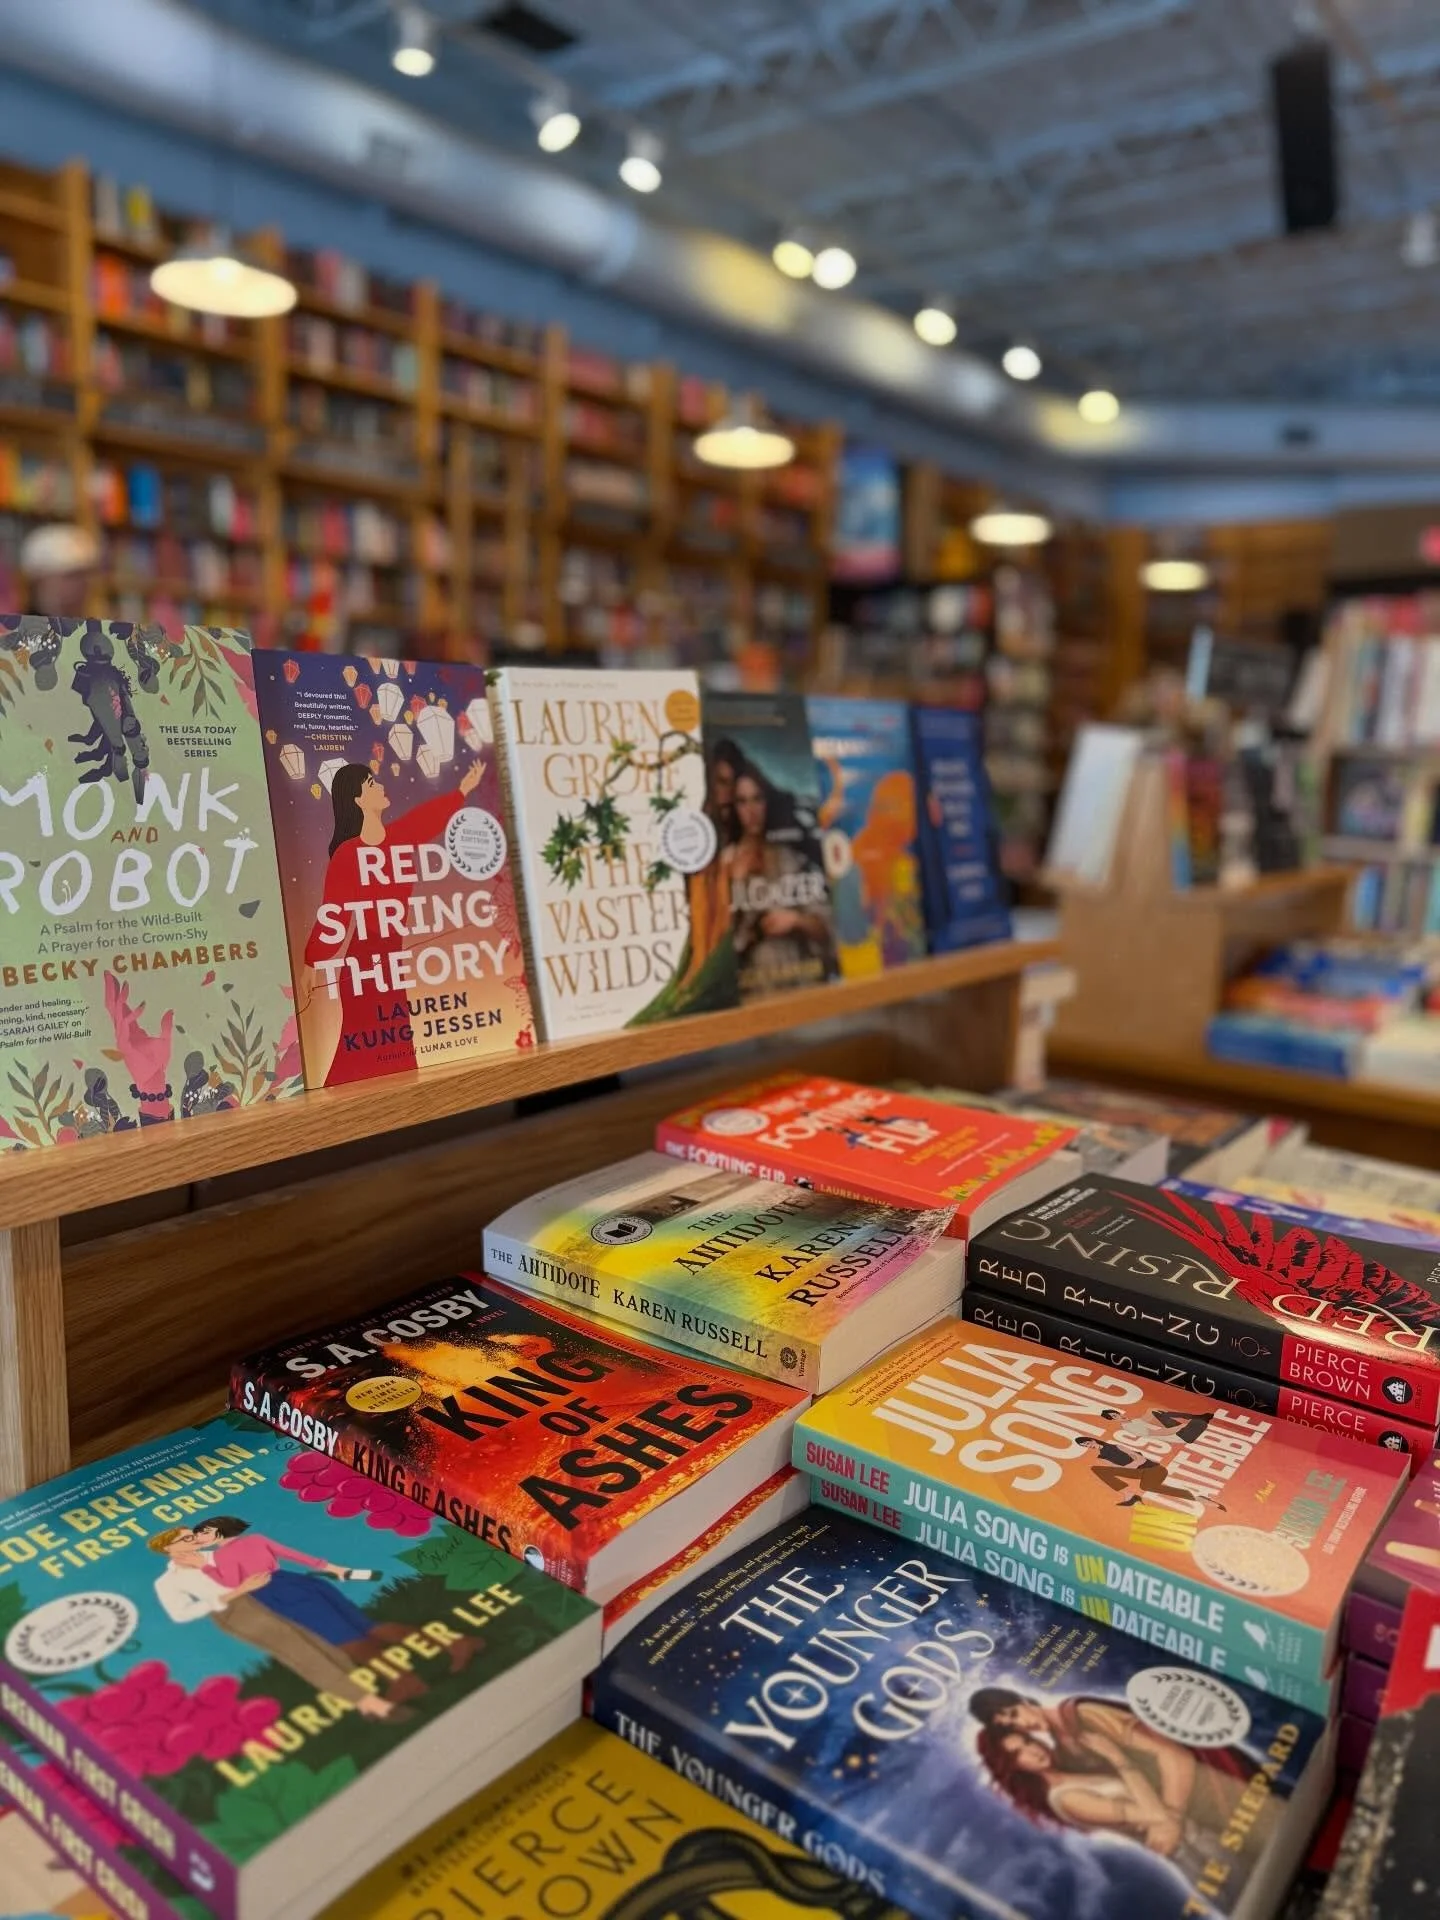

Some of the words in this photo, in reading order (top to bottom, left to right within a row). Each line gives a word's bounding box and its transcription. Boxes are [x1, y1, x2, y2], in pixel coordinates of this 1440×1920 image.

[294, 701, 327, 710] Beautifully
[304, 691, 332, 699] devoured
[511, 699, 661, 746] LAUREN
[159, 725, 179, 734] THE
[181, 725, 201, 734] USA
[204, 725, 237, 735] TODAY
[167, 737, 232, 746] BESTSELLING
[184, 749, 218, 758] SERIES
[0, 767, 240, 841] MONK
[544, 752, 680, 798] GROFF
[110, 826, 159, 844] AND
[0, 838, 259, 915] ROBOT
[356, 842, 451, 888] RED
[575, 842, 650, 890] THE
[38, 942, 49, 955] A
[51, 937, 93, 955] Prayer
[97, 936, 115, 949] for
[118, 933, 139, 946] the
[142, 928, 208, 943] Crown-Shy
[40, 925, 50, 936] A
[54, 921, 93, 936] Psalm
[96, 919, 115, 932] for
[118, 917, 138, 930] the
[141, 912, 202, 927] Wild-Built
[316, 890, 497, 946] STRING
[547, 890, 690, 944] VASTER
[2, 958, 98, 988] BECKY
[113, 941, 258, 973] CHAMBERS
[313, 938, 511, 1000] THEORY
[543, 940, 677, 998] WILDS
[24, 1001, 40, 1010] and
[26, 1012, 45, 1022] kind,
[37, 1021, 69, 1031] GAILEY
[343, 1024, 414, 1052] KUNG
[423, 1008, 502, 1037] JESSEN
[377, 991, 468, 1022] LAUREN
[26, 1038, 37, 1046] for
[39, 1035, 52, 1043] the
[53, 1029, 92, 1041] Wild-Built
[420, 1041, 452, 1054] LUNAR
[455, 1036, 478, 1047] LOVE
[665, 1141, 684, 1157] THE
[688, 1144, 756, 1178] FORTUNE
[820, 1184, 860, 1202] LAUREN
[674, 1195, 815, 1275] ANTIDOTE
[688, 1209, 733, 1232] THE
[754, 1220, 863, 1283] KAREN
[787, 1225, 915, 1307] RUSSELL
[1000, 1219, 1243, 1301] RISING
[362, 1289, 492, 1347] COSBY
[476, 1310, 507, 1325] NOVEL
[491, 1248, 513, 1265] THE
[518, 1254, 601, 1299] ANTIDOTE
[612, 1288, 676, 1325] KAREN
[681, 1314, 768, 1358] RUSSELL
[979, 1260, 1046, 1295] RED
[1065, 1285, 1219, 1346] RISING
[1295, 1344, 1370, 1379] PIERCE
[1273, 1293, 1440, 1354] RED
[355, 1389, 373, 1399] NEW
[375, 1380, 396, 1391] YORK
[368, 1386, 416, 1410] BESTSELLER
[372, 1387, 397, 1400] TIMES
[423, 1352, 614, 1442] KING
[721, 1376, 744, 1388] POST
[975, 1308, 1041, 1343] RED
[1060, 1337, 1215, 1397] RISING
[1291, 1396, 1366, 1432] PIERCE
[1289, 1362, 1371, 1400] BROWN
[539, 1398, 610, 1436] OF
[872, 1343, 1057, 1456] JULIA
[959, 1364, 1144, 1492] SONG
[279, 1401, 339, 1456] COSBY
[353, 1442, 406, 1494] KING
[411, 1481, 429, 1505] OF
[435, 1489, 512, 1554] ASHES
[518, 1384, 753, 1532] ASHES
[60, 1443, 269, 1533] BRENNAN,
[40, 1518, 148, 1578] FIRST
[152, 1468, 268, 1524] CRUSH
[807, 1441, 855, 1479] SUSAN
[860, 1463, 890, 1494] LEE
[904, 1481, 968, 1530] JULIA
[974, 1510, 1047, 1560] SONG
[1053, 1543, 1069, 1566] IS
[1074, 1553, 1226, 1634] UNDATEABLE
[653, 1624, 671, 1639] work
[670, 1616, 678, 1625] of
[678, 1608, 689, 1618] art
[698, 1588, 716, 1600] This
[715, 1567, 748, 1589] enthralling
[716, 1590, 735, 1603] York
[732, 1578, 752, 1592] Times
[750, 1557, 781, 1580] bestselling
[719, 1567, 844, 1644] THE
[821, 1480, 869, 1520] SUSAN
[873, 1500, 902, 1530] LEE
[915, 1523, 977, 1567] JULIA
[984, 1549, 1054, 1599] SONG
[1061, 1584, 1074, 1605] IS
[1081, 1597, 1227, 1674] UNDATEABLE
[724, 1558, 970, 1751] YOUNGER
[853, 1619, 994, 1741] GODS
[216, 1691, 359, 1788] LAURA
[350, 1620, 464, 1695] PIPER
[453, 1583, 524, 1627] LEE
[73, 1747, 118, 1806] FIRST
[120, 1790, 176, 1861] CRUSH
[615, 1711, 661, 1760] THE
[671, 1745, 797, 1841] YOUNGER
[804, 1829, 887, 1899] GODS
[1221, 1722, 1300, 1850] SHEPARD
[52, 1812, 94, 1873] FIRST
